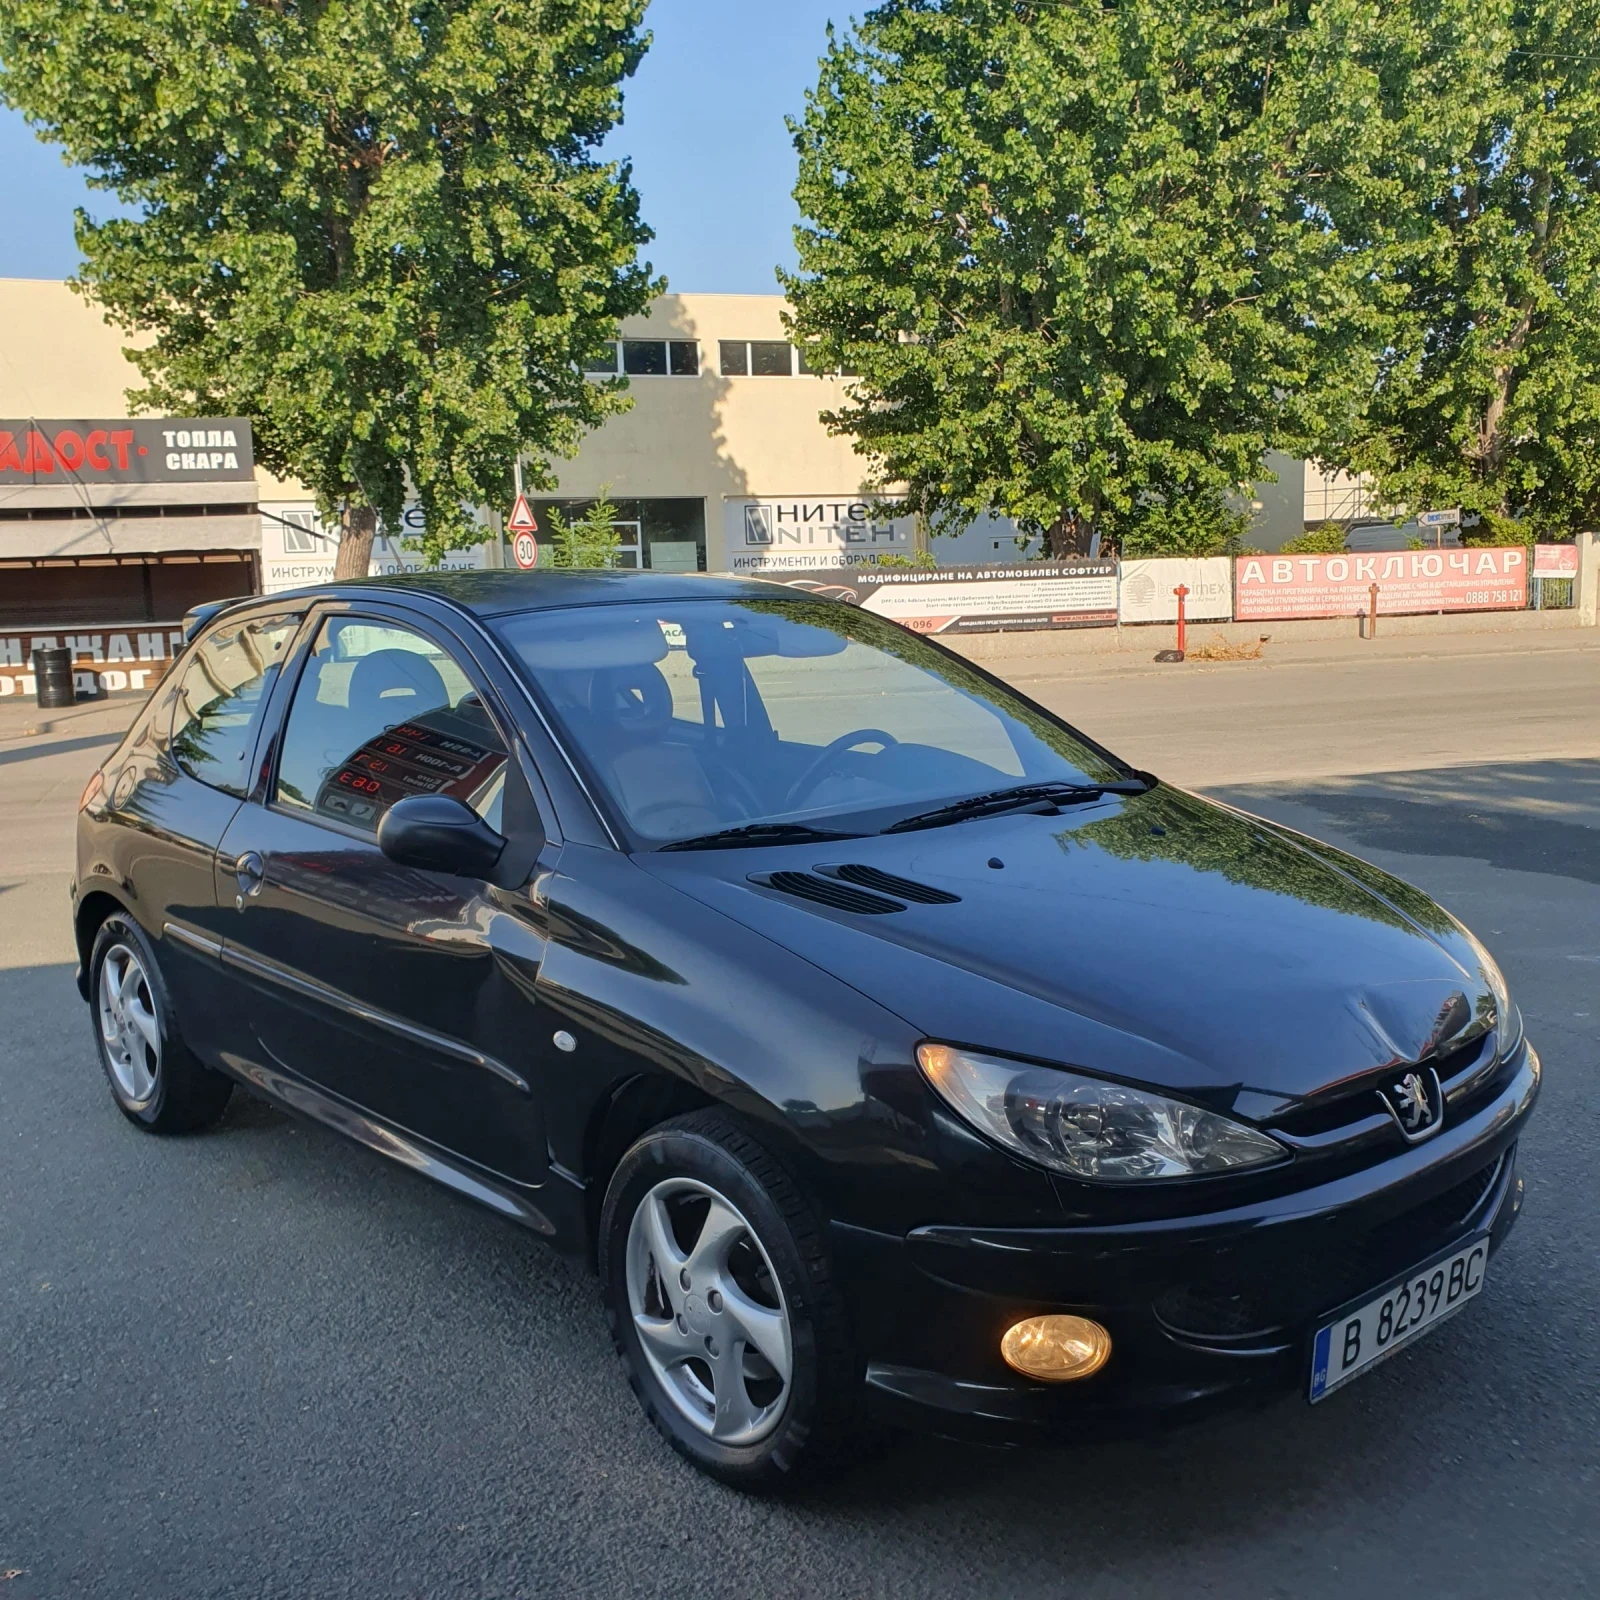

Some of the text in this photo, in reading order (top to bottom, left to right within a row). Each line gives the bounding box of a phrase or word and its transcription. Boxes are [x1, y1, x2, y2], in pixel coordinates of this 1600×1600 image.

[162, 430, 238, 448] ТОПЛА
[166, 453, 239, 470] СКАРА
[519, 541, 533, 560] 30
[734, 556, 816, 568] ИНСТРУМЕНТИ
[820, 556, 827, 566] И
[1240, 551, 1523, 584] АВТОКЛЮЧАР
[272, 566, 335, 578] ИНСТРУМ
[857, 566, 1112, 584] МОДИФИЦИРАНЕ НА АВТОМОБИЛЕН СОФТУЕР
[1466, 589, 1523, 604] 0888 758 121
[913, 620, 933, 629] 096
[1342, 1318, 1361, 1370] B
[1314, 1369, 1327, 1387] BG
